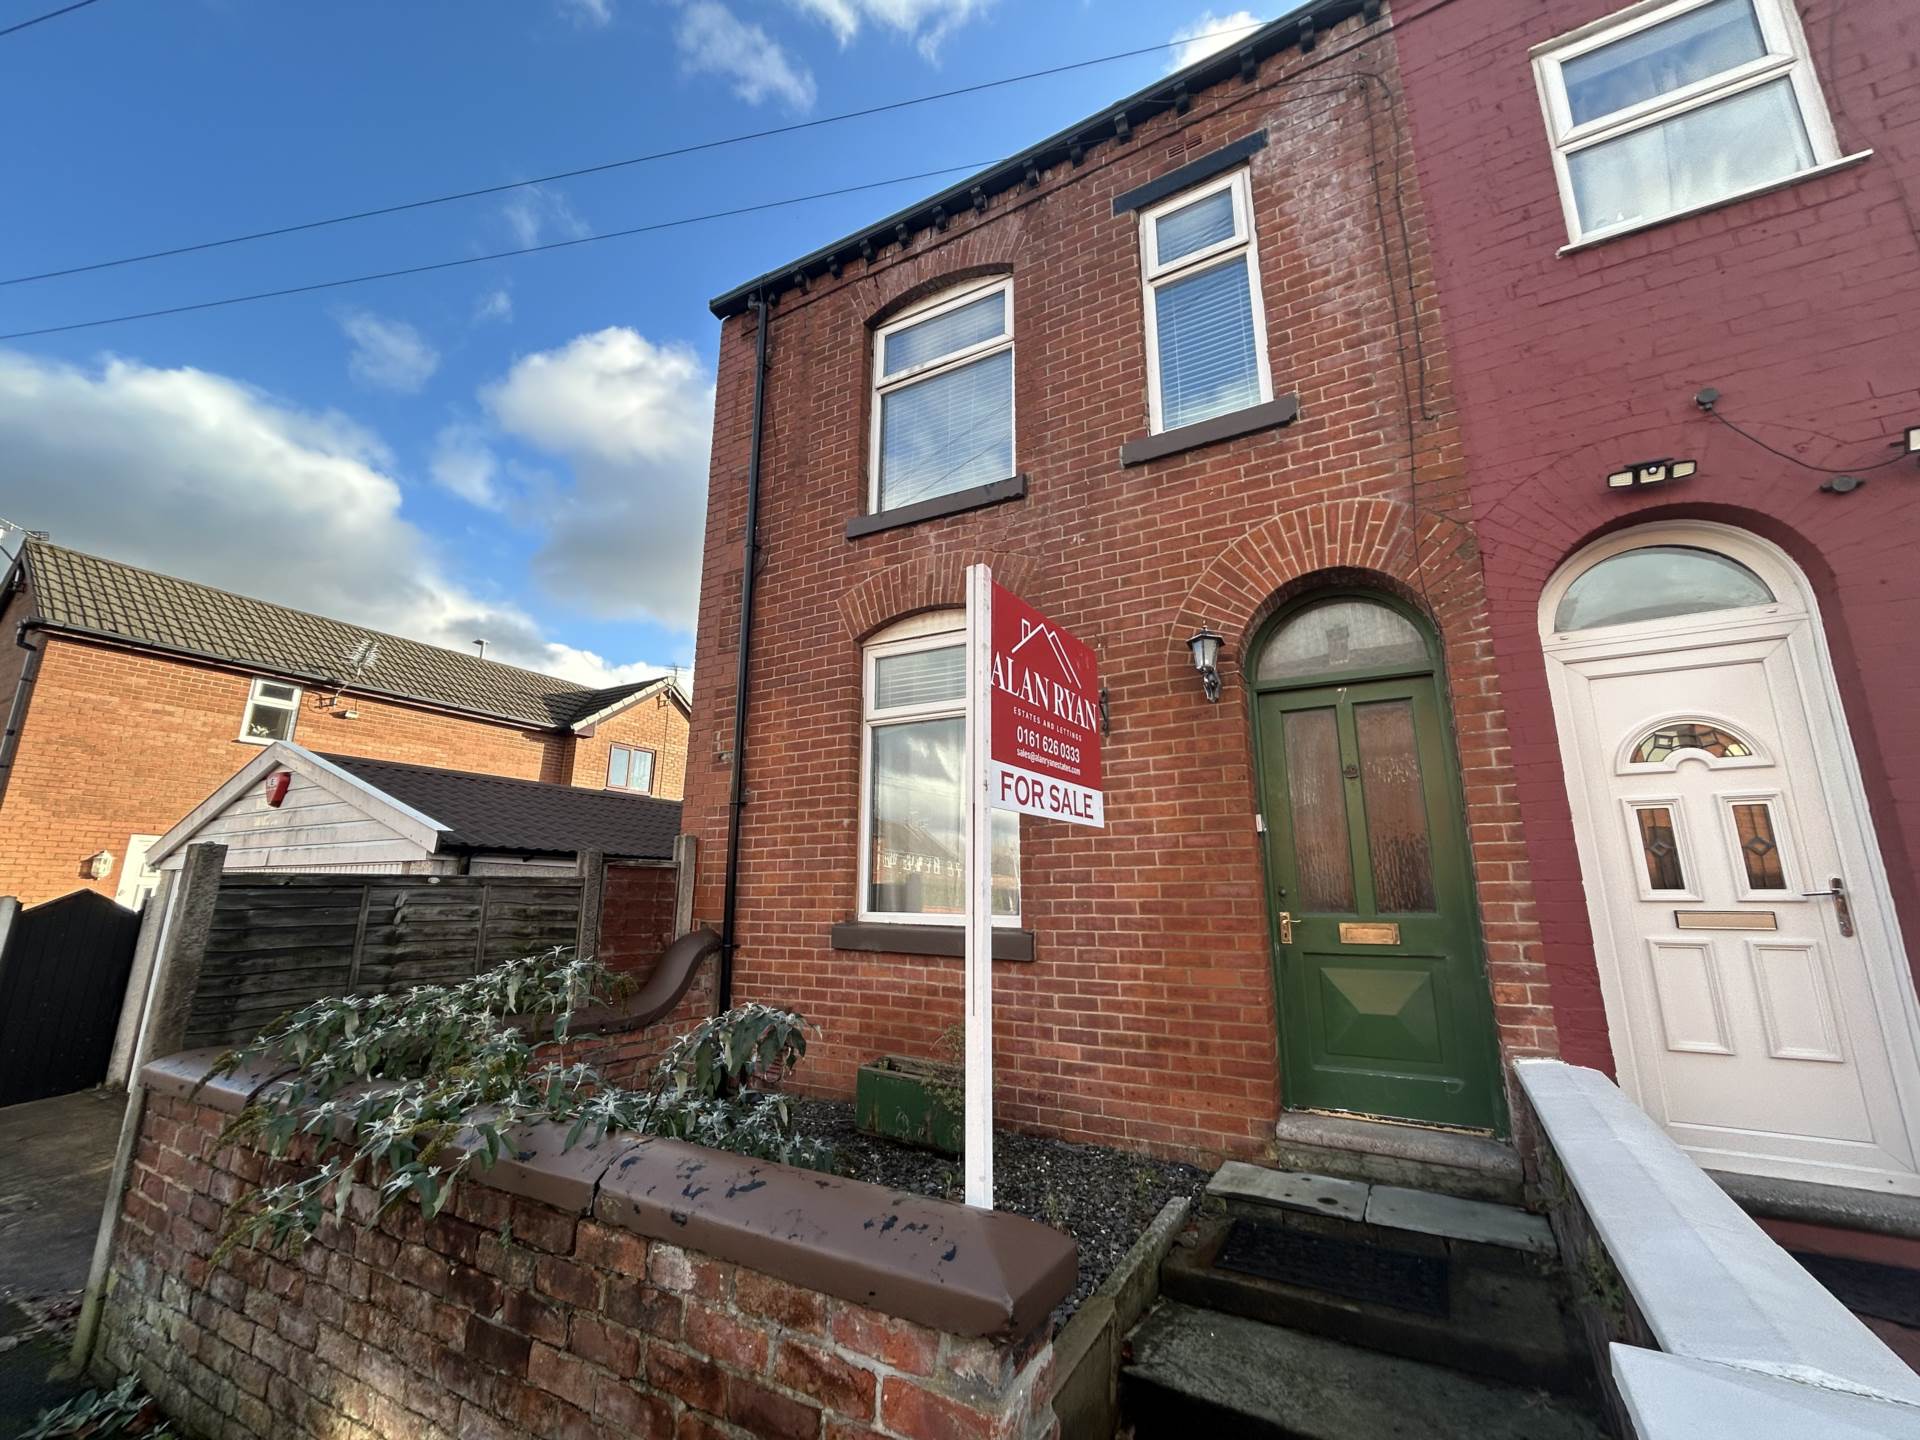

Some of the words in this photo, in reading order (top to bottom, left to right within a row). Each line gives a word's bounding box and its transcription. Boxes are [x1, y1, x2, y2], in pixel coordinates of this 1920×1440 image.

[990, 651, 1049, 711] ALAN
[1053, 682, 1096, 733] RYAN
[1013, 707, 1040, 724] ESTATES
[1043, 720, 1054, 730] AND
[1056, 725, 1082, 741] LETTINGS
[1016, 726, 1040, 748] 0161
[1042, 736, 1058, 756] 626
[1060, 742, 1080, 763] 0333
[1001, 770, 1045, 809] FOR
[1049, 784, 1094, 819] SALE
